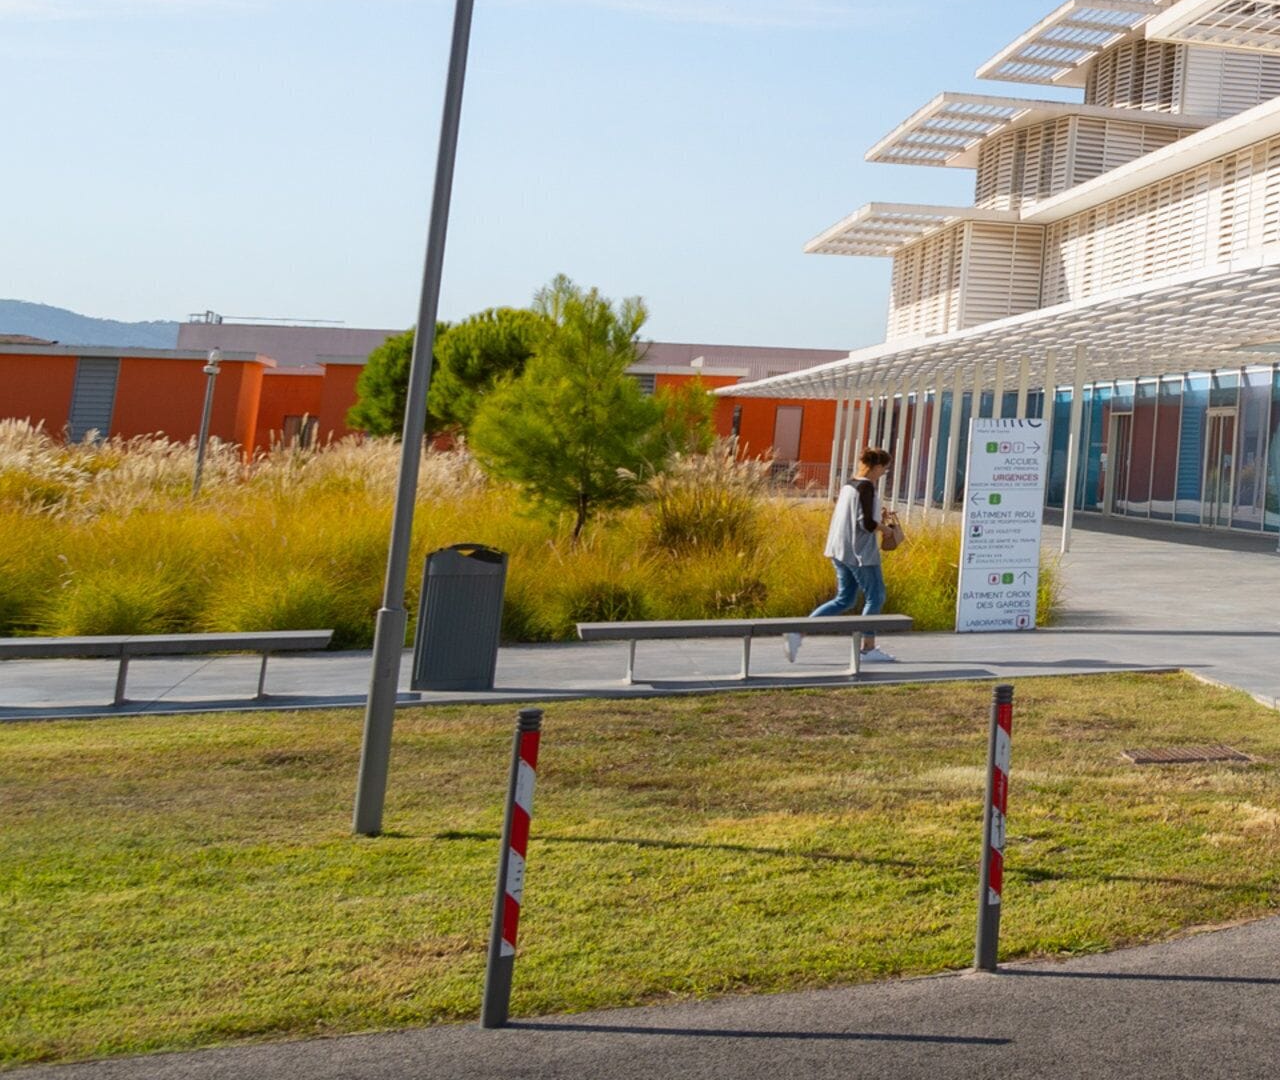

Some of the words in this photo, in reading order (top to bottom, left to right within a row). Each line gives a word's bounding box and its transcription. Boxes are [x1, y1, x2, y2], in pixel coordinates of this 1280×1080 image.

[993, 473, 1039, 481] URGENCES
[970, 510, 1012, 519] BÂTIMENT
[1015, 510, 1035, 518] RIOU
[963, 591, 1003, 600] BÂTIMENT
[1006, 590, 1031, 598] CROIX
[976, 601, 994, 609] DES
[995, 600, 1031, 608] GARDES
[966, 618, 1014, 627] LABORATOIRE
